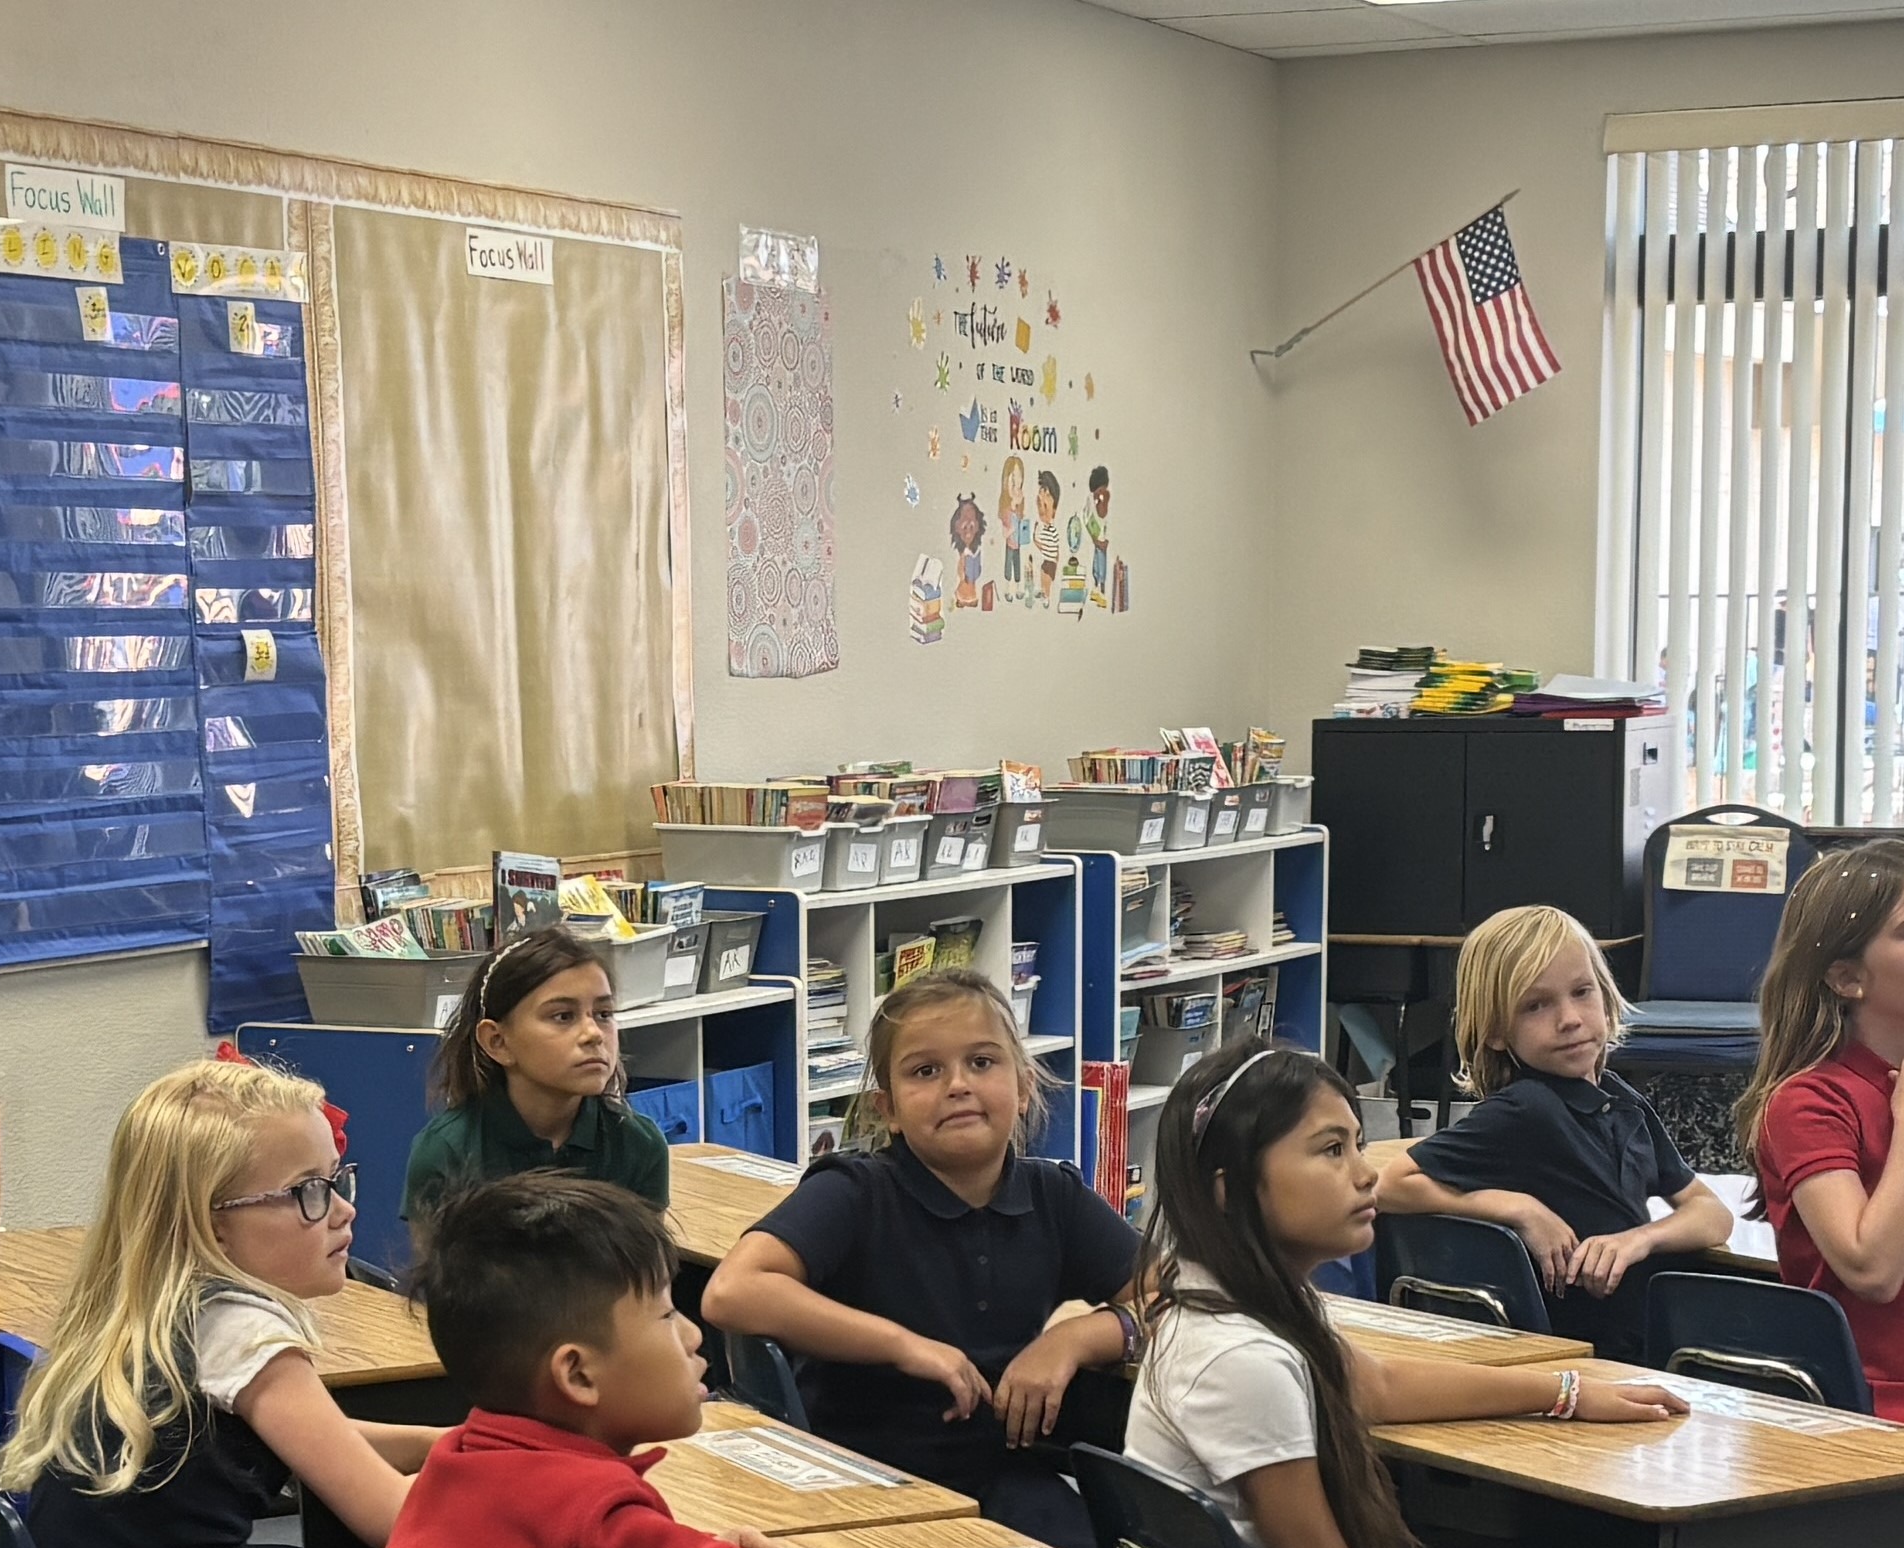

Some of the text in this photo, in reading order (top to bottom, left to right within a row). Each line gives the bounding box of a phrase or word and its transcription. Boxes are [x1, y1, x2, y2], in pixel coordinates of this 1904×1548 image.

[10, 171, 116, 217] Focus Wall
[468, 235, 544, 273] Focus Wall
